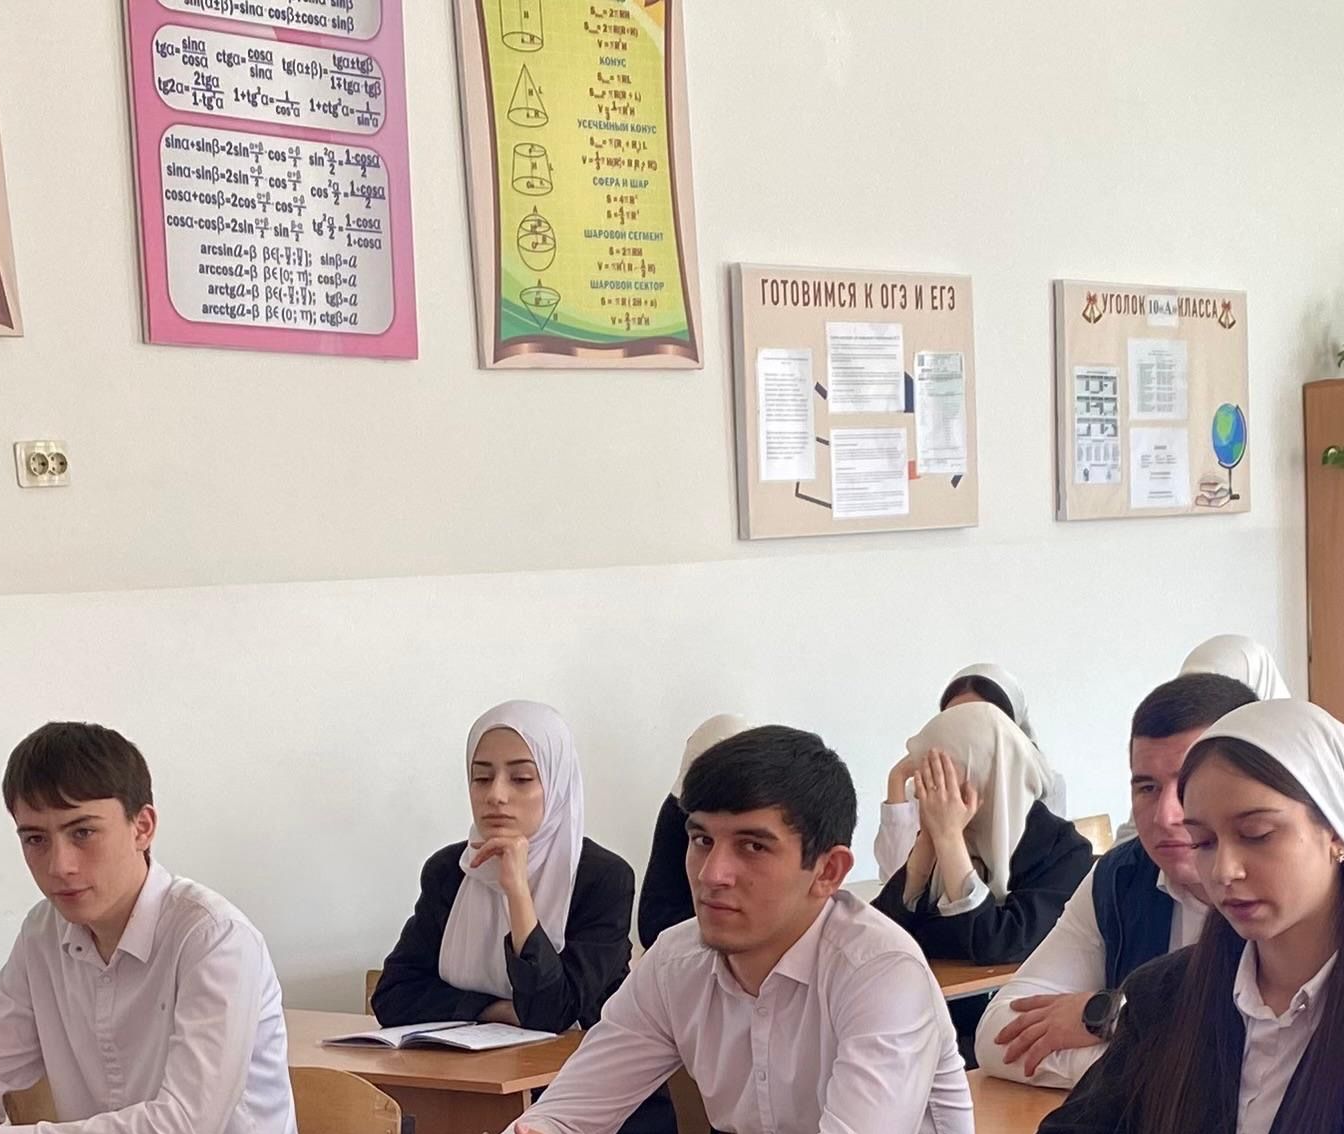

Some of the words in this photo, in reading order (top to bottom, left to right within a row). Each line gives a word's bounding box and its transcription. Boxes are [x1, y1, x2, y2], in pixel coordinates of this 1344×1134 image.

[599, 56, 627, 68] КОНУС
[630, 122, 657, 134] КОНУС
[592, 176, 620, 187] СФЕРА
[630, 179, 649, 190] ШАР
[628, 231, 664, 241] СЕГМЕНТ
[634, 281, 665, 291] СЕКТОР
[761, 278, 857, 309] ГОТОВИМСЯ
[864, 282, 874, 309] К
[880, 283, 907, 310] ОГЭ
[915, 284, 924, 310] И
[931, 285, 956, 311] ЕГЭ
[1102, 292, 1146, 315] УГОЛОК
[1177, 295, 1218, 319] КЛАССА
